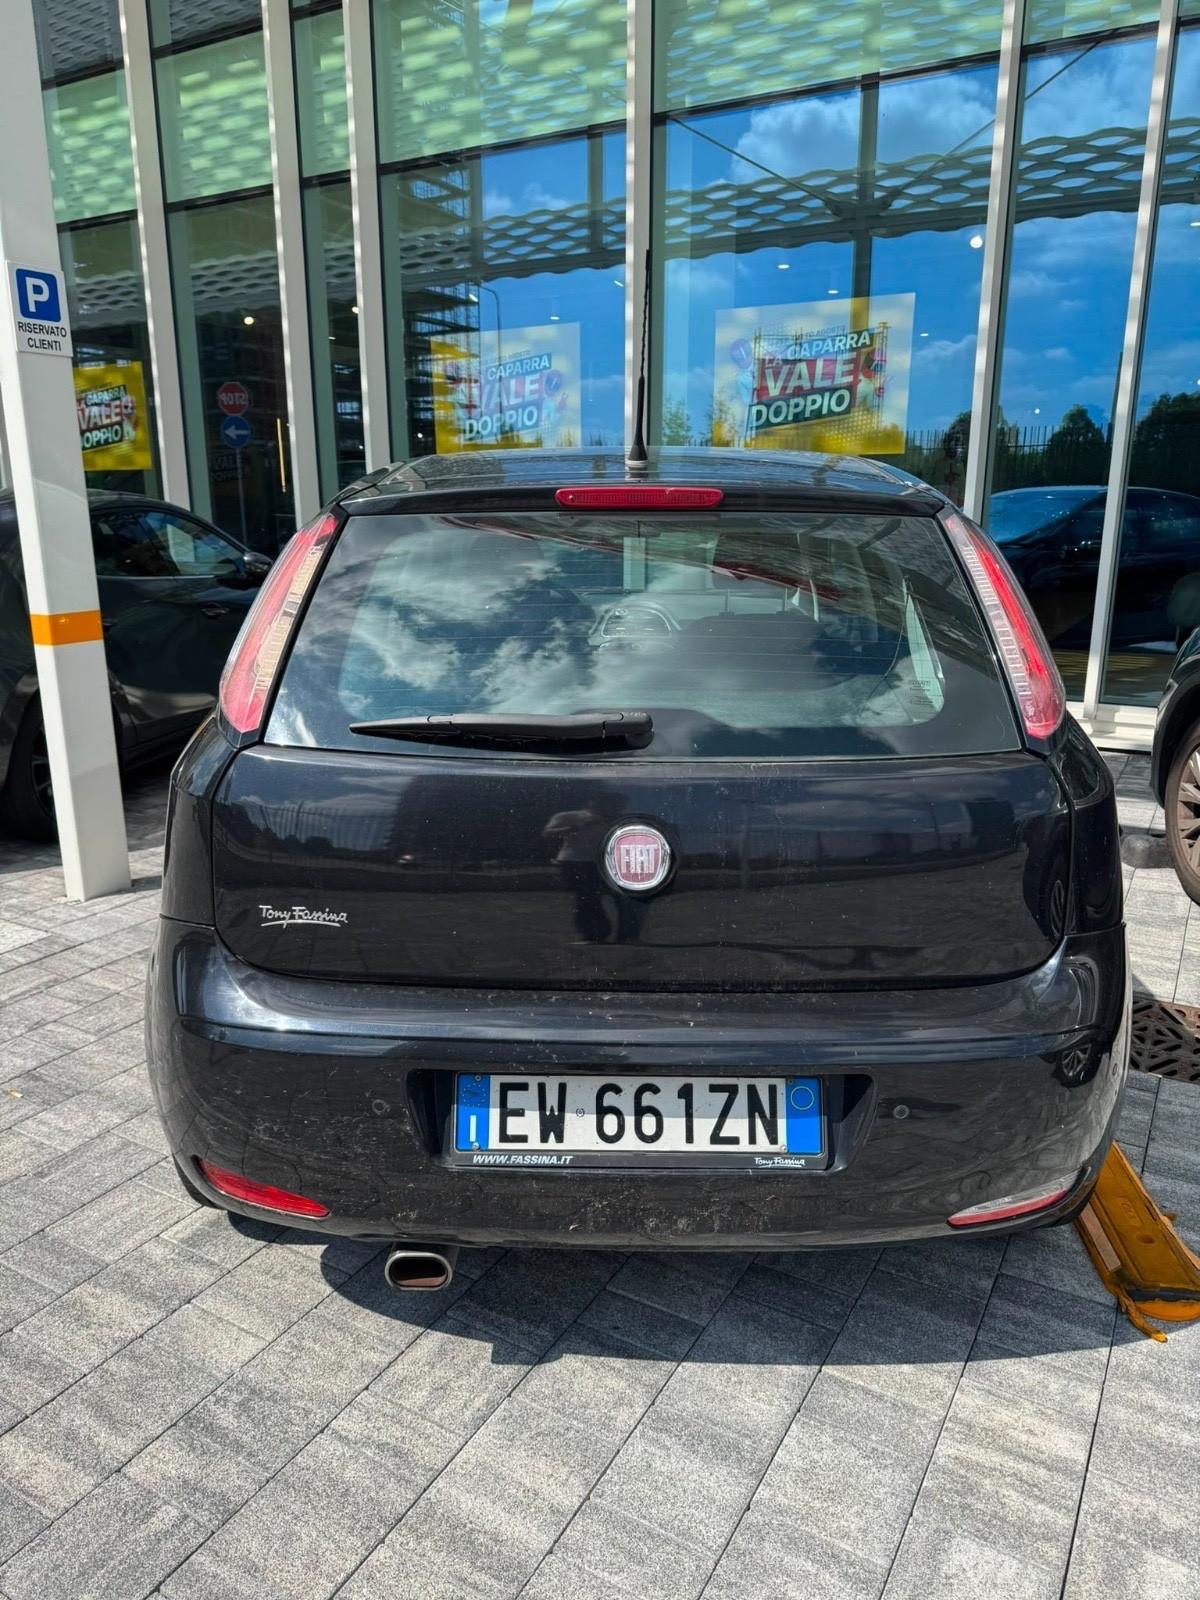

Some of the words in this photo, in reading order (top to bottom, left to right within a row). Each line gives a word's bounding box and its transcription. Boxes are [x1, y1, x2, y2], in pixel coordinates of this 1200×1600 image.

[25, 277, 49, 313] P
[18, 321, 67, 338] RISERVATO
[27, 337, 62, 351] CLIENTI
[787, 330, 871, 360] CAPARRA
[487, 354, 550, 381] CAPARRA
[765, 352, 857, 397] VALE
[86, 385, 126, 405] CAPARRA
[750, 389, 851, 427] DOPPIO
[78, 401, 122, 430] VALE
[465, 405, 538, 440] DOPPIO
[81, 425, 122, 448] OPPIO
[620, 844, 658, 874] FIAT
[258, 905, 291, 928] Tony
[291, 906, 348, 923] Fassina
[499, 1082, 567, 1144] EW
[595, 1082, 779, 1145] 661ZN
[470, 1115, 477, 1142] I
[472, 1155, 573, 1165] WWW.FASSINA.IT
[753, 1157, 772, 1168] Tony
[772, 1157, 805, 1166] Fassina
